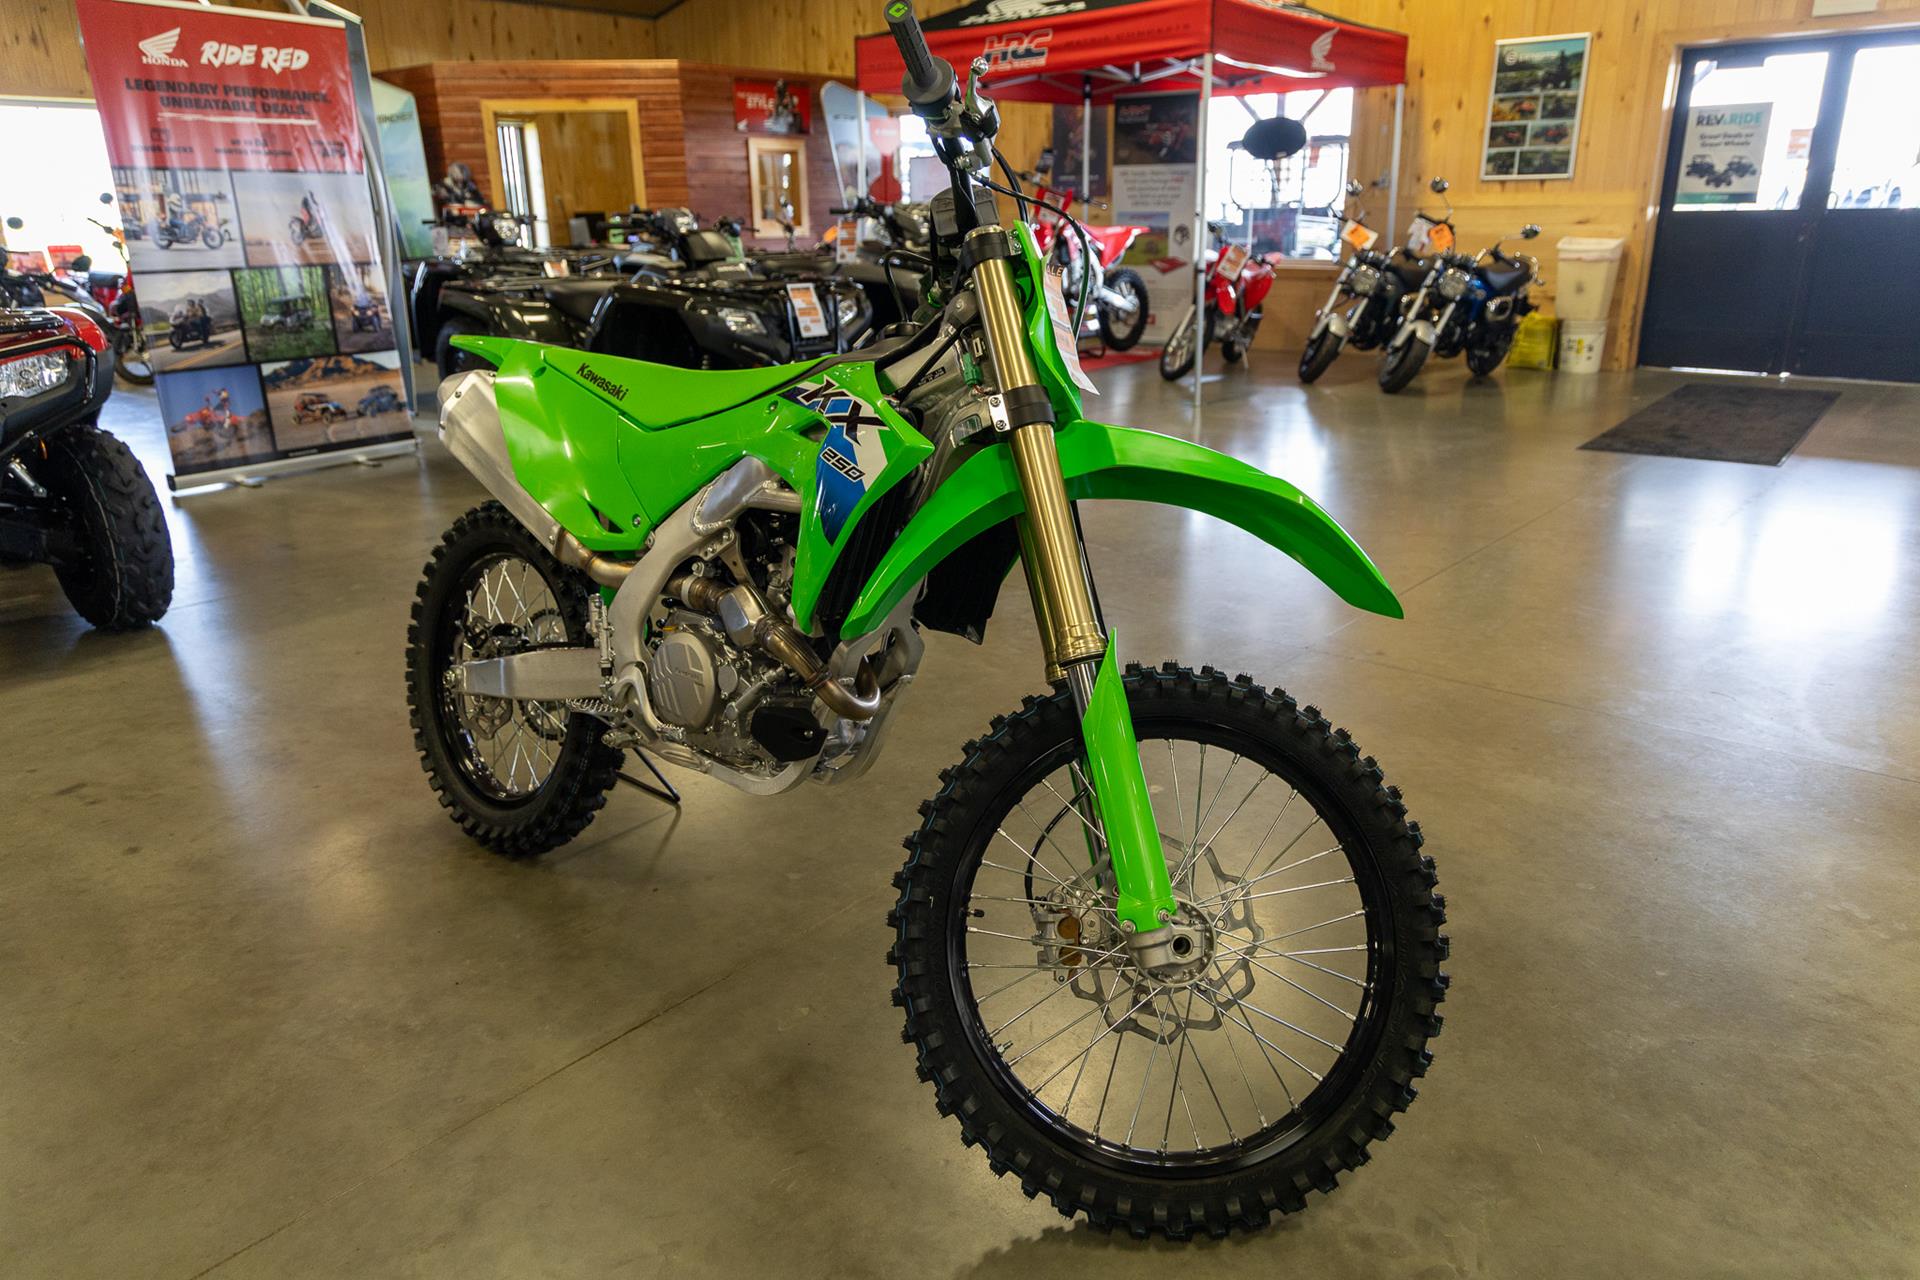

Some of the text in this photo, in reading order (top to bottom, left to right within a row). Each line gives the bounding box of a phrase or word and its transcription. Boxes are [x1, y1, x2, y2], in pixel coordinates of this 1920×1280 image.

[142, 55, 189, 68] HONDA
[200, 40, 310, 75] RIDE RED
[983, 28, 1053, 63] HRC
[125, 78, 219, 95] LEGENDARY
[159, 96, 257, 113] UNBEATABLE
[576, 362, 629, 401] Kawasaki
[797, 375, 890, 446] KX
[820, 446, 866, 483] 250
